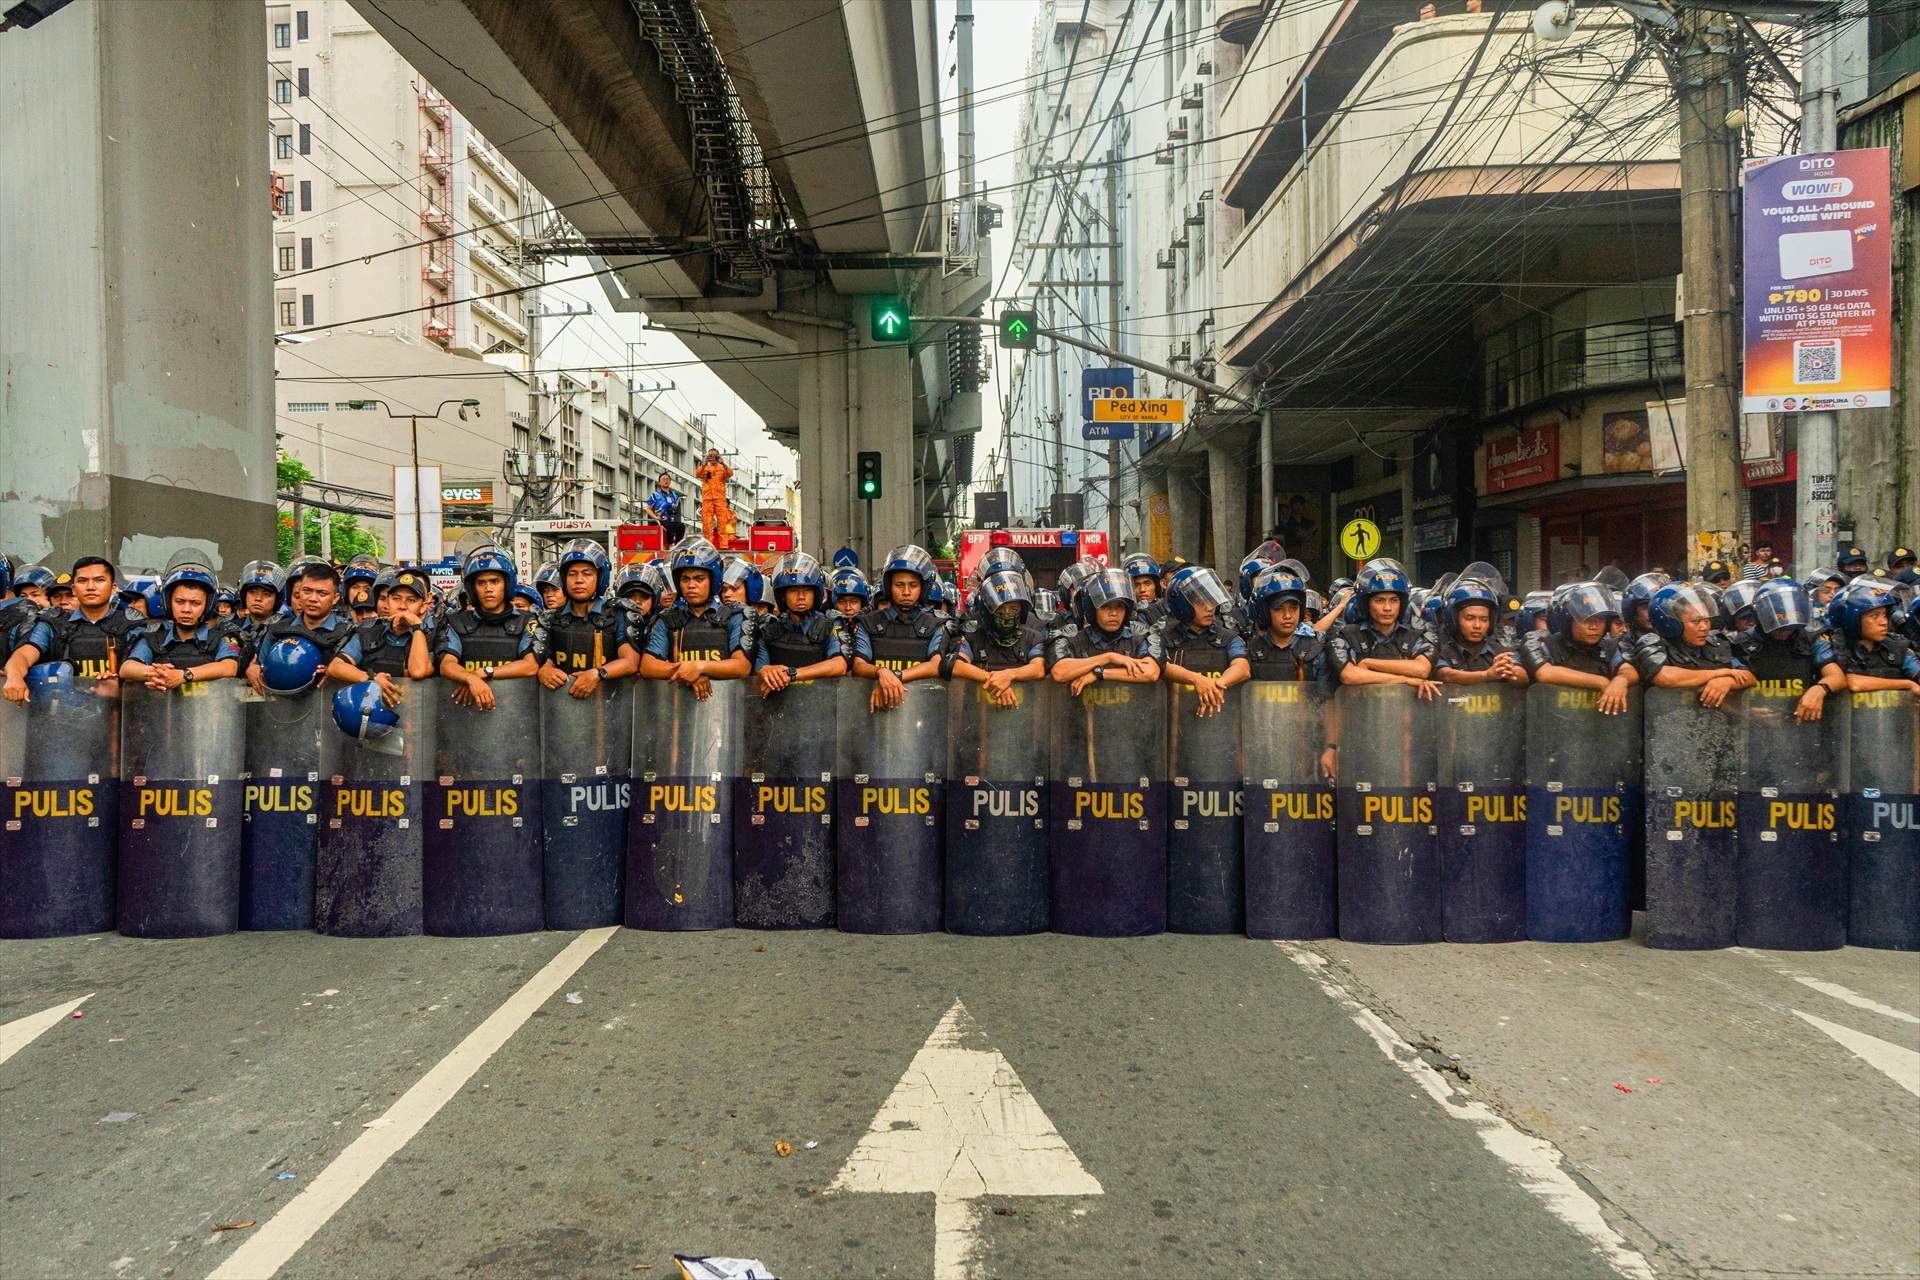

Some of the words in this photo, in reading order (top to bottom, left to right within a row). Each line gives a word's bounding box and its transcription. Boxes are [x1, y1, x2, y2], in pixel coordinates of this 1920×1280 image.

[1800, 158, 1835, 170] DITO
[1762, 206, 1794, 216] YOUR
[1796, 201, 1876, 214] ALL-AROUND
[1781, 213, 1818, 223] HOME
[1809, 256, 1832, 266] DITO
[1831, 290, 1843, 298] 30
[1844, 288, 1869, 297] DAYS
[1759, 314, 1783, 322] WITH
[1784, 313, 1805, 321] DITO
[1806, 312, 1819, 320] 5G
[1820, 310, 1860, 319] STARTER
[1861, 309, 1877, 317] KIT
[1764, 307, 1785, 315] UNLI
[1786, 305, 1798, 314] 5G
[1806, 304, 1817, 312] 50
[1847, 302, 1871, 310] DATA
[1795, 320, 1807, 328] AT
[1088, 385, 1128, 401] BDO
[1111, 401, 1136, 412] Ped
[1139, 401, 1168, 416] Xing
[1089, 426, 1109, 435] ATM
[984, 521, 1000, 529] BFP
[968, 534, 985, 544] BFP
[1012, 534, 1056, 545] MANILA
[1085, 534, 1102, 544] NCR
[15, 789, 94, 818] PULIS
[140, 789, 213, 816] PULIS
[245, 785, 313, 812] PULIS
[337, 789, 405, 817] PULIS
[448, 789, 518, 816] PULIS
[570, 784, 631, 812] PULIS
[650, 785, 716, 812] PULIS
[758, 786, 826, 813] PULIS
[862, 787, 930, 814] PULIS
[973, 790, 1039, 817] PULIS
[1075, 791, 1144, 819] PULIS
[1182, 790, 1245, 817] PULIS
[1271, 793, 1333, 820] PULIS
[1364, 796, 1433, 823] PULIS
[1556, 796, 1621, 823] PULIS
[1674, 800, 1736, 828] PULIS
[1769, 801, 1835, 830] PULIS
